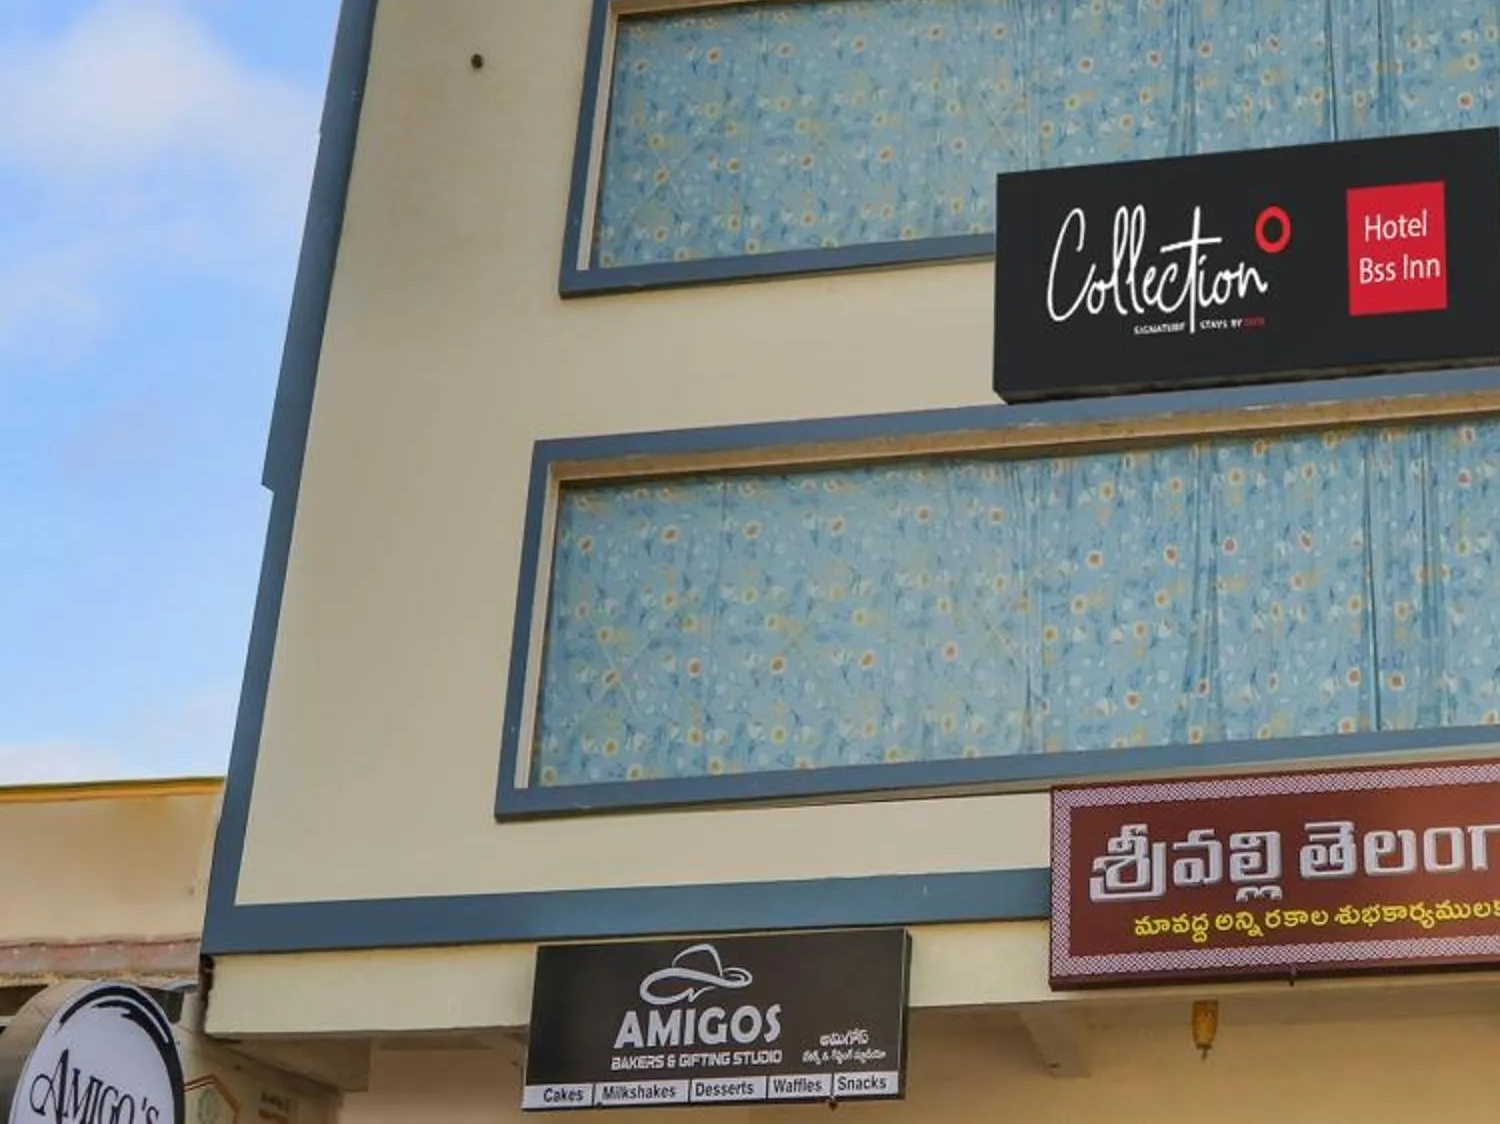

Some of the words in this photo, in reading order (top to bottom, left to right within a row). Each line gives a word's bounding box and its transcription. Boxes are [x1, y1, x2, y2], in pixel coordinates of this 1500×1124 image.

[1364, 209, 1429, 243] Hotel
[1047, 204, 1268, 334] Collection
[1358, 257, 1397, 285] Bss
[1402, 254, 1442, 281] Inn
[1088, 821, 1284, 904] శ్రీవల్లి
[1214, 910, 1265, 939] అన్ని
[1264, 909, 1330, 931] రకాల
[612, 1003, 782, 1050] AMIGOS
[610, 1054, 665, 1071] BAKERS
[667, 1054, 676, 1068] &
[678, 1052, 731, 1068] GIFTING
[732, 1049, 783, 1066] STUDIO
[543, 1087, 584, 1103] Cakes
[601, 1083, 677, 1101] Milkshakes
[695, 1081, 755, 1098] Desserts
[773, 1077, 823, 1094] Waffles
[837, 1075, 888, 1091] Snacks
